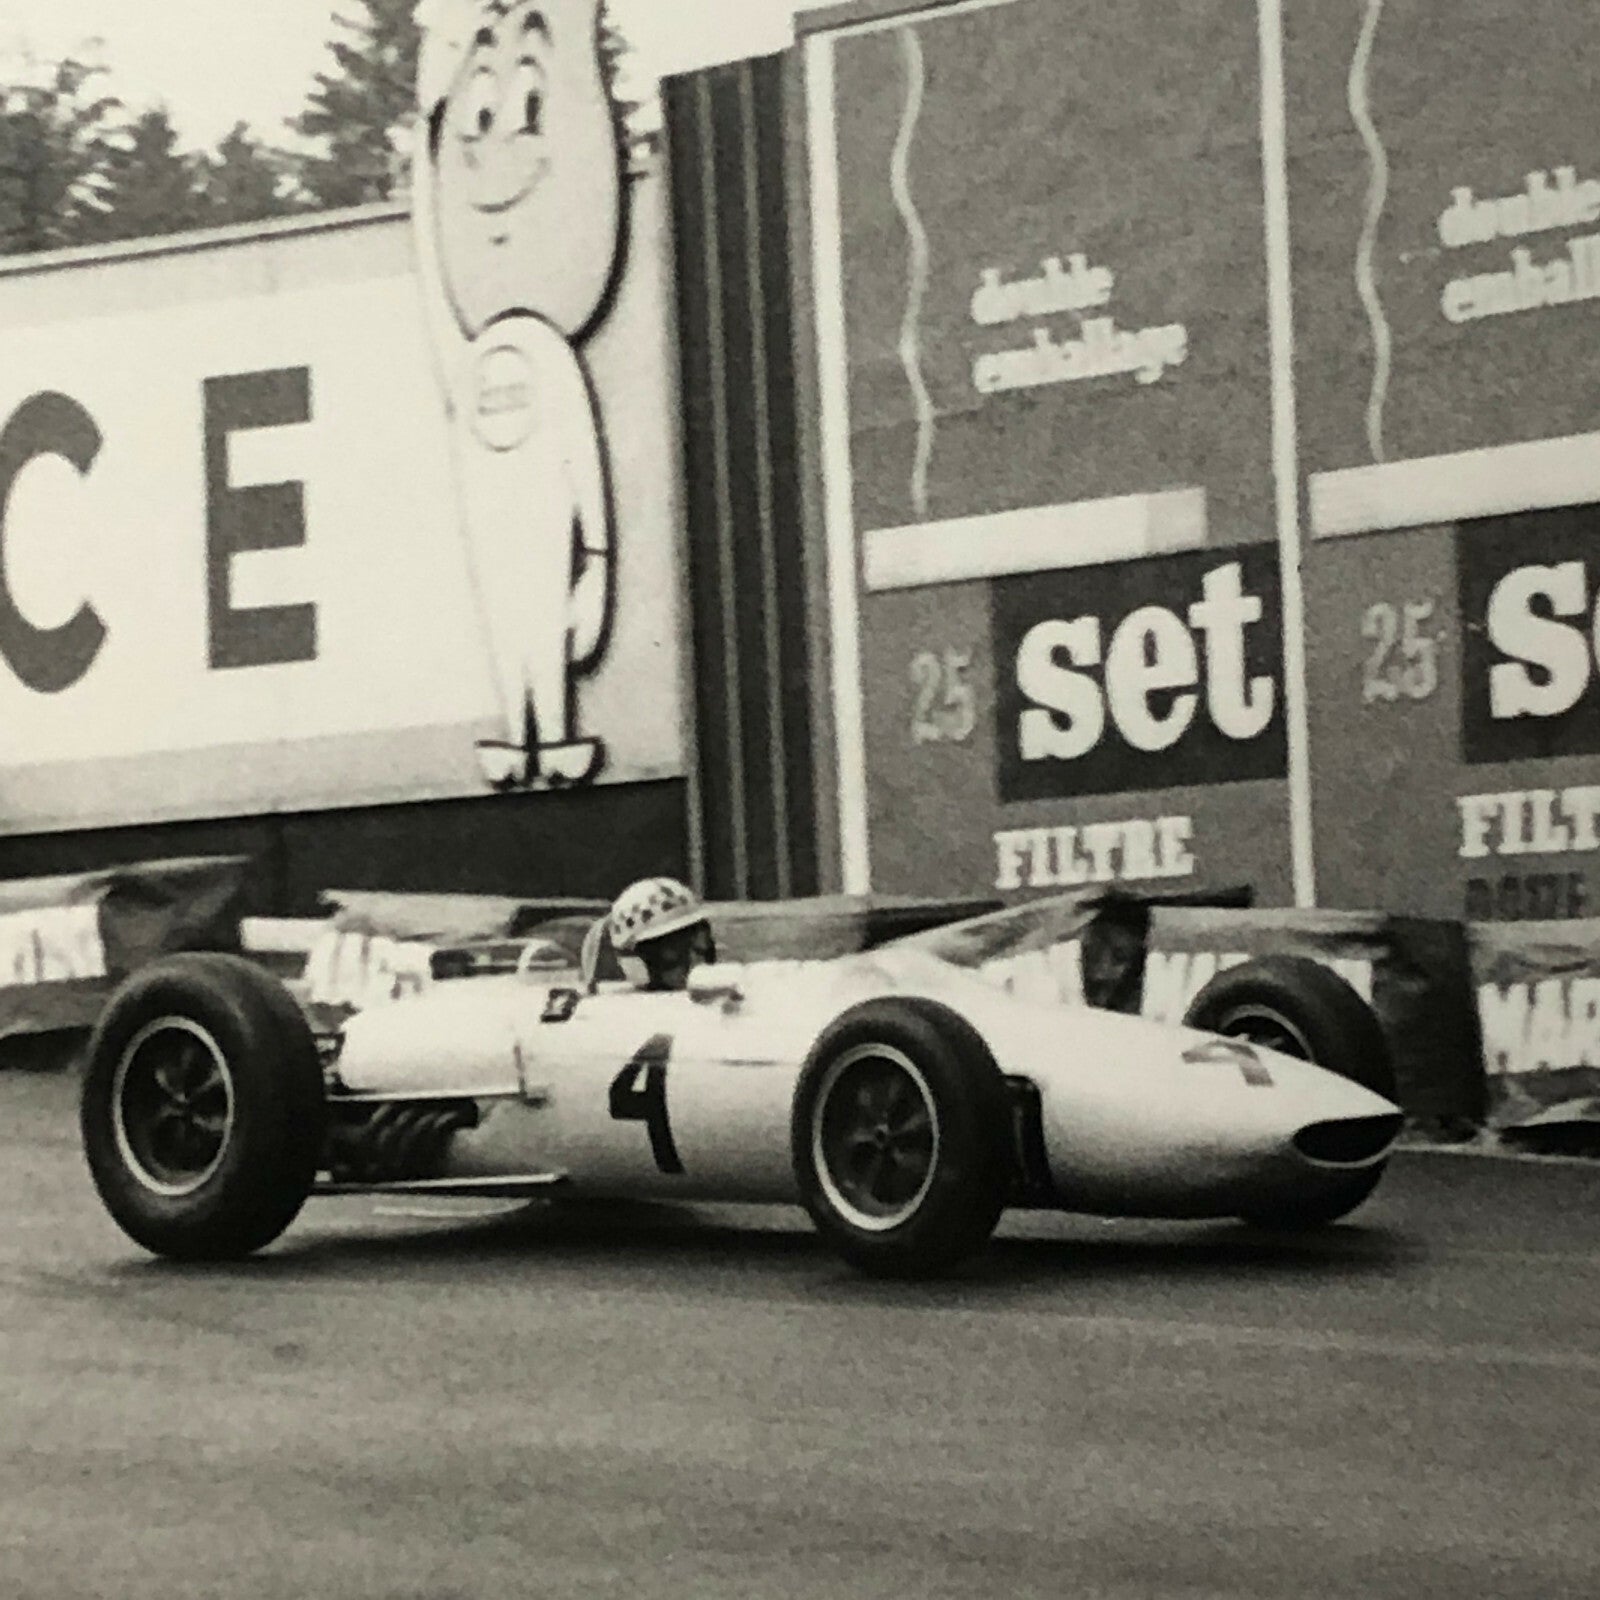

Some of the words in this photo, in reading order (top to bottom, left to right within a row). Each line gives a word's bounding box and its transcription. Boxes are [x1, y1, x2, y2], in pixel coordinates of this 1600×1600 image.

[908, 645, 978, 744] 25
[1016, 562, 1274, 761] set
[1361, 599, 1438, 703] 25
[1487, 561, 1600, 719] s
[992, 815, 1196, 890] FILTRE
[608, 1033, 687, 1175] 4
